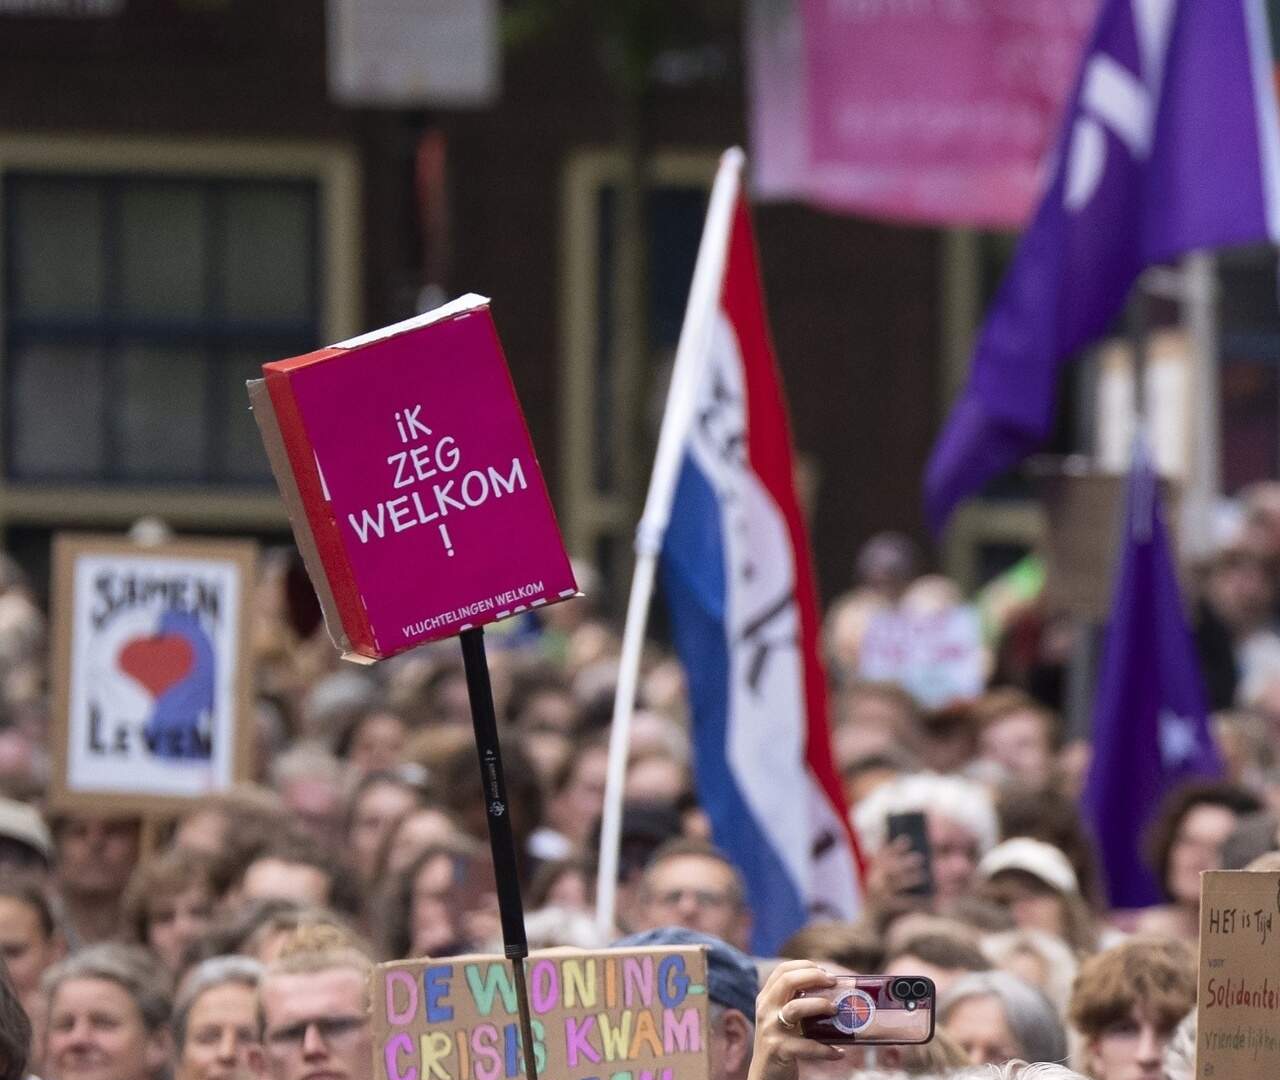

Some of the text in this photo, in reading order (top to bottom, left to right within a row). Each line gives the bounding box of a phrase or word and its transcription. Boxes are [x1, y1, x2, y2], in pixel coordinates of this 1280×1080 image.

[387, 436, 460, 489] ZEG
[348, 457, 528, 544] WELKOM
[438, 523, 455, 558] !
[92, 568, 220, 632] SAMEN
[402, 580, 545, 638] VLUCHTELINGEN WELKOM
[1209, 907, 1237, 934] HET
[384, 964, 455, 1027] DE
[564, 1007, 702, 1068] KWAM
